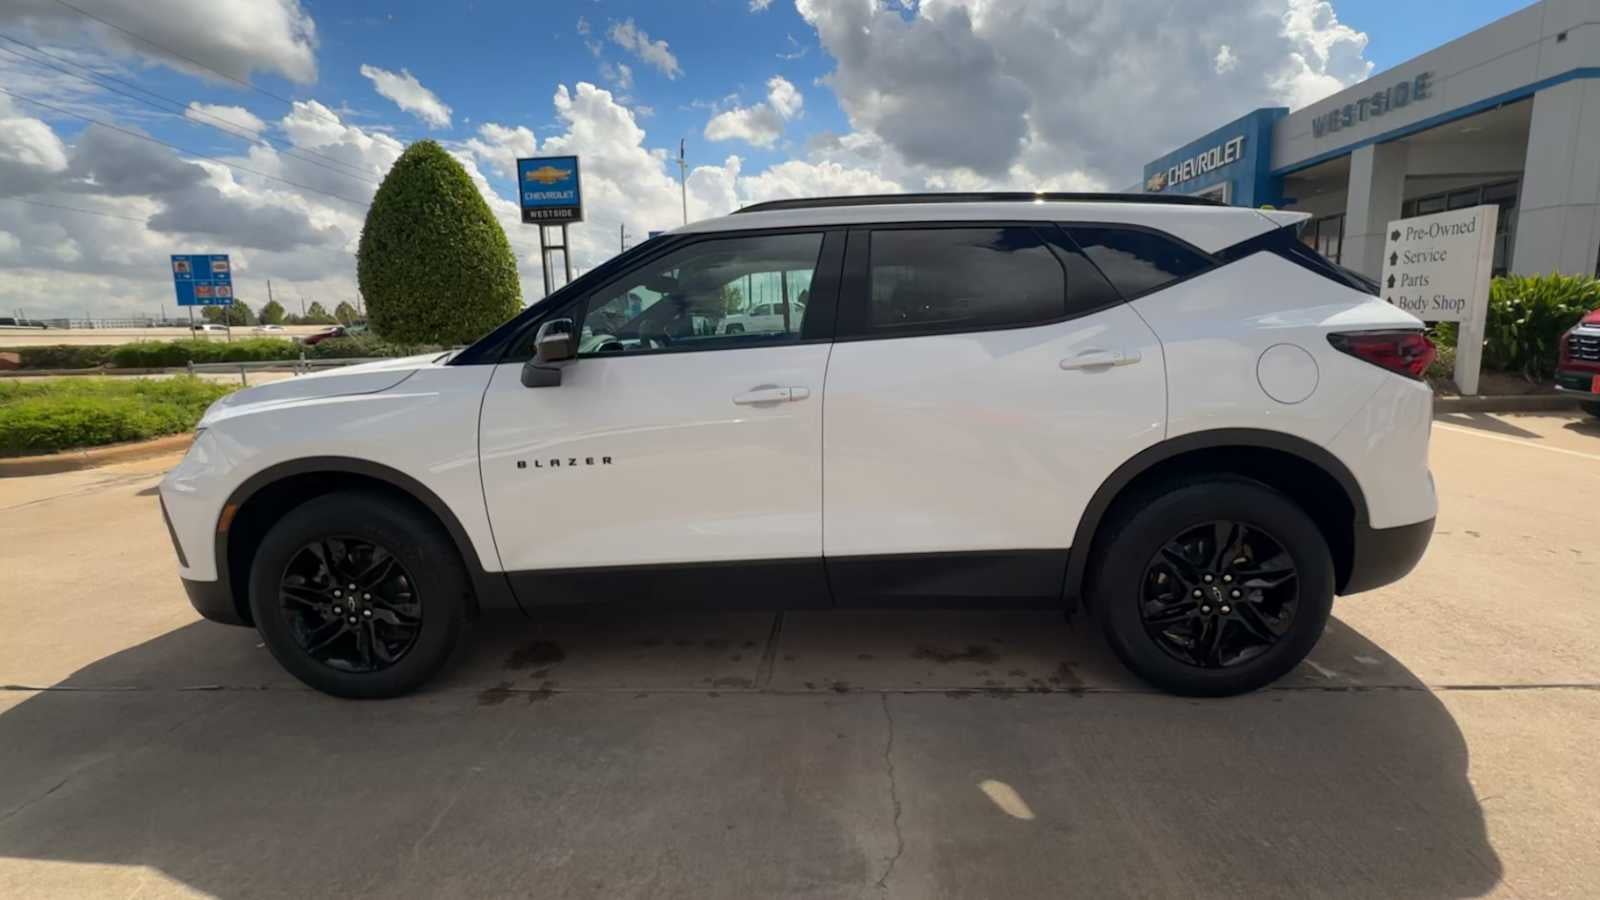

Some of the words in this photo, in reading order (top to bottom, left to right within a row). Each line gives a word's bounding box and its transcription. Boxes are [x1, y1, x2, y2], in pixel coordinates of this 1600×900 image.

[1312, 71, 1434, 138] WESTSIDE
[1167, 135, 1244, 186] CHEVROLET
[524, 191, 574, 200] CHEVROLET
[530, 208, 572, 218] WESTSIDE
[1405, 216, 1476, 241] Pre-Owned
[1403, 248, 1447, 265] Service
[1400, 273, 1430, 288] Parts
[1399, 296, 1427, 314] Body
[1432, 295, 1465, 314] Shop
[517, 456, 612, 469] BLAZER
